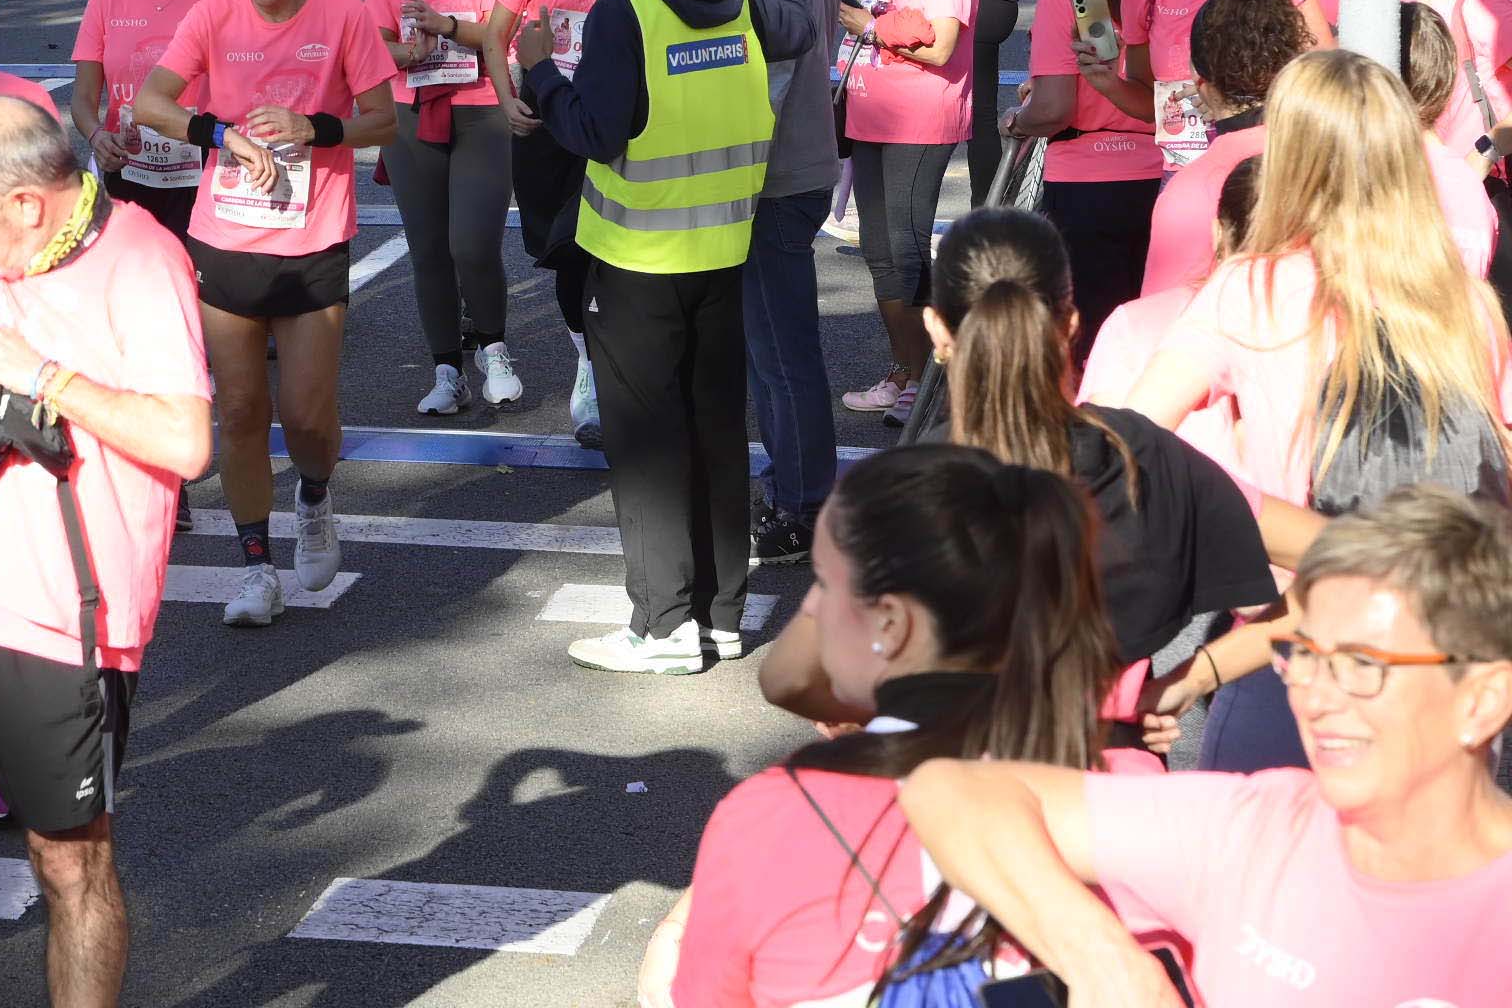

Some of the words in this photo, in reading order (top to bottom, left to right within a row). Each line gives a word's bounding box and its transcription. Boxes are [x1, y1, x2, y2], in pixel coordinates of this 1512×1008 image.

[110, 18, 148, 27] OYSHO
[226, 51, 265, 63] OYSHO
[668, 43, 743, 67] VOLUNTARIS
[847, 72, 866, 90] MA
[143, 141, 171, 153] 016
[1093, 141, 1136, 152] OYSHO
